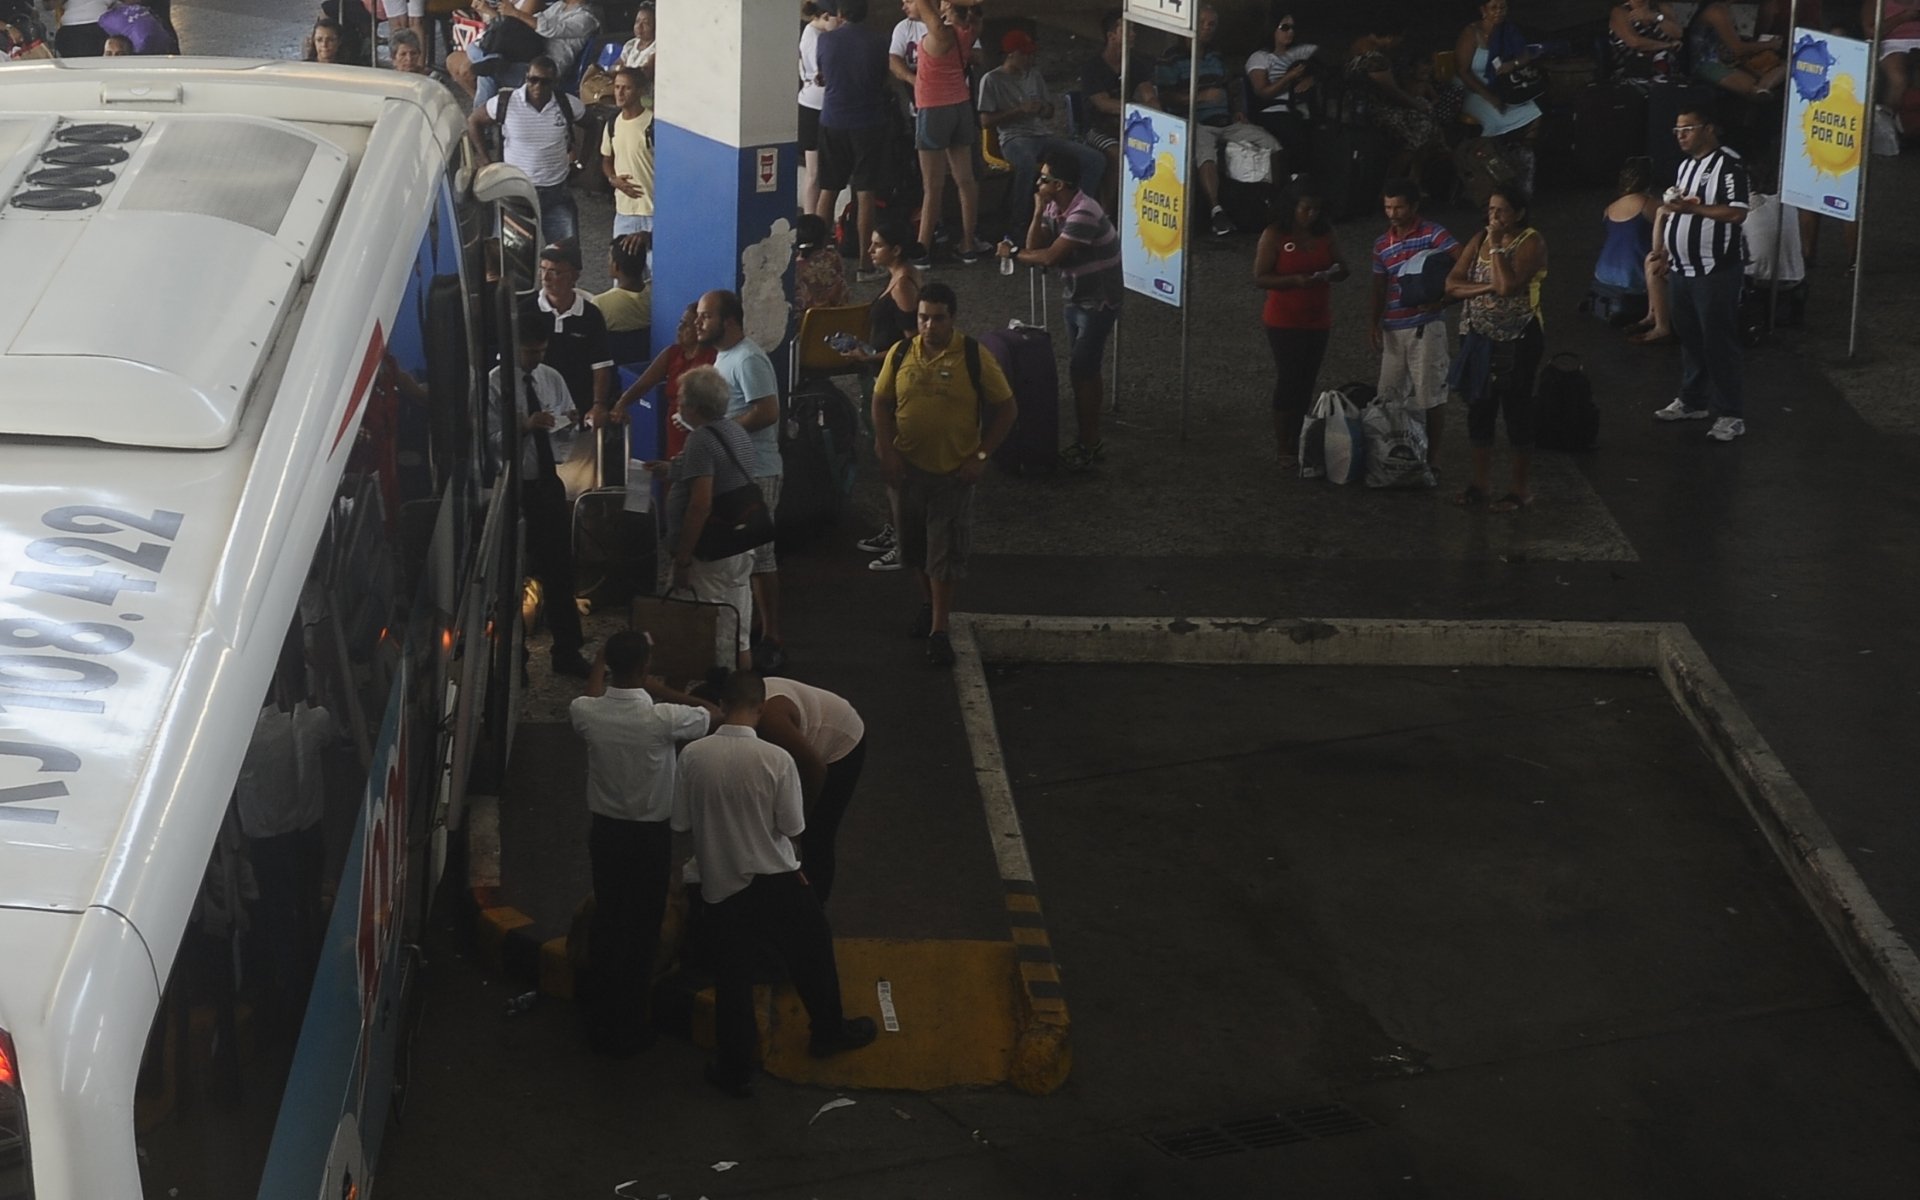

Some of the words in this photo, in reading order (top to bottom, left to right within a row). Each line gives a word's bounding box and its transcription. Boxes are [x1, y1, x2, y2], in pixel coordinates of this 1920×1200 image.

[1812, 109, 1847, 127] AGORA
[1850, 117, 1857, 131] É
[1811, 125, 1833, 142] POR
[1836, 131, 1855, 148] DIA
[1142, 188, 1171, 213] AGORA
[1173, 196, 1179, 212] É
[1141, 205, 1160, 224] POR
[1161, 213, 1178, 230] DIA
[0, 505, 185, 714] 108.422
